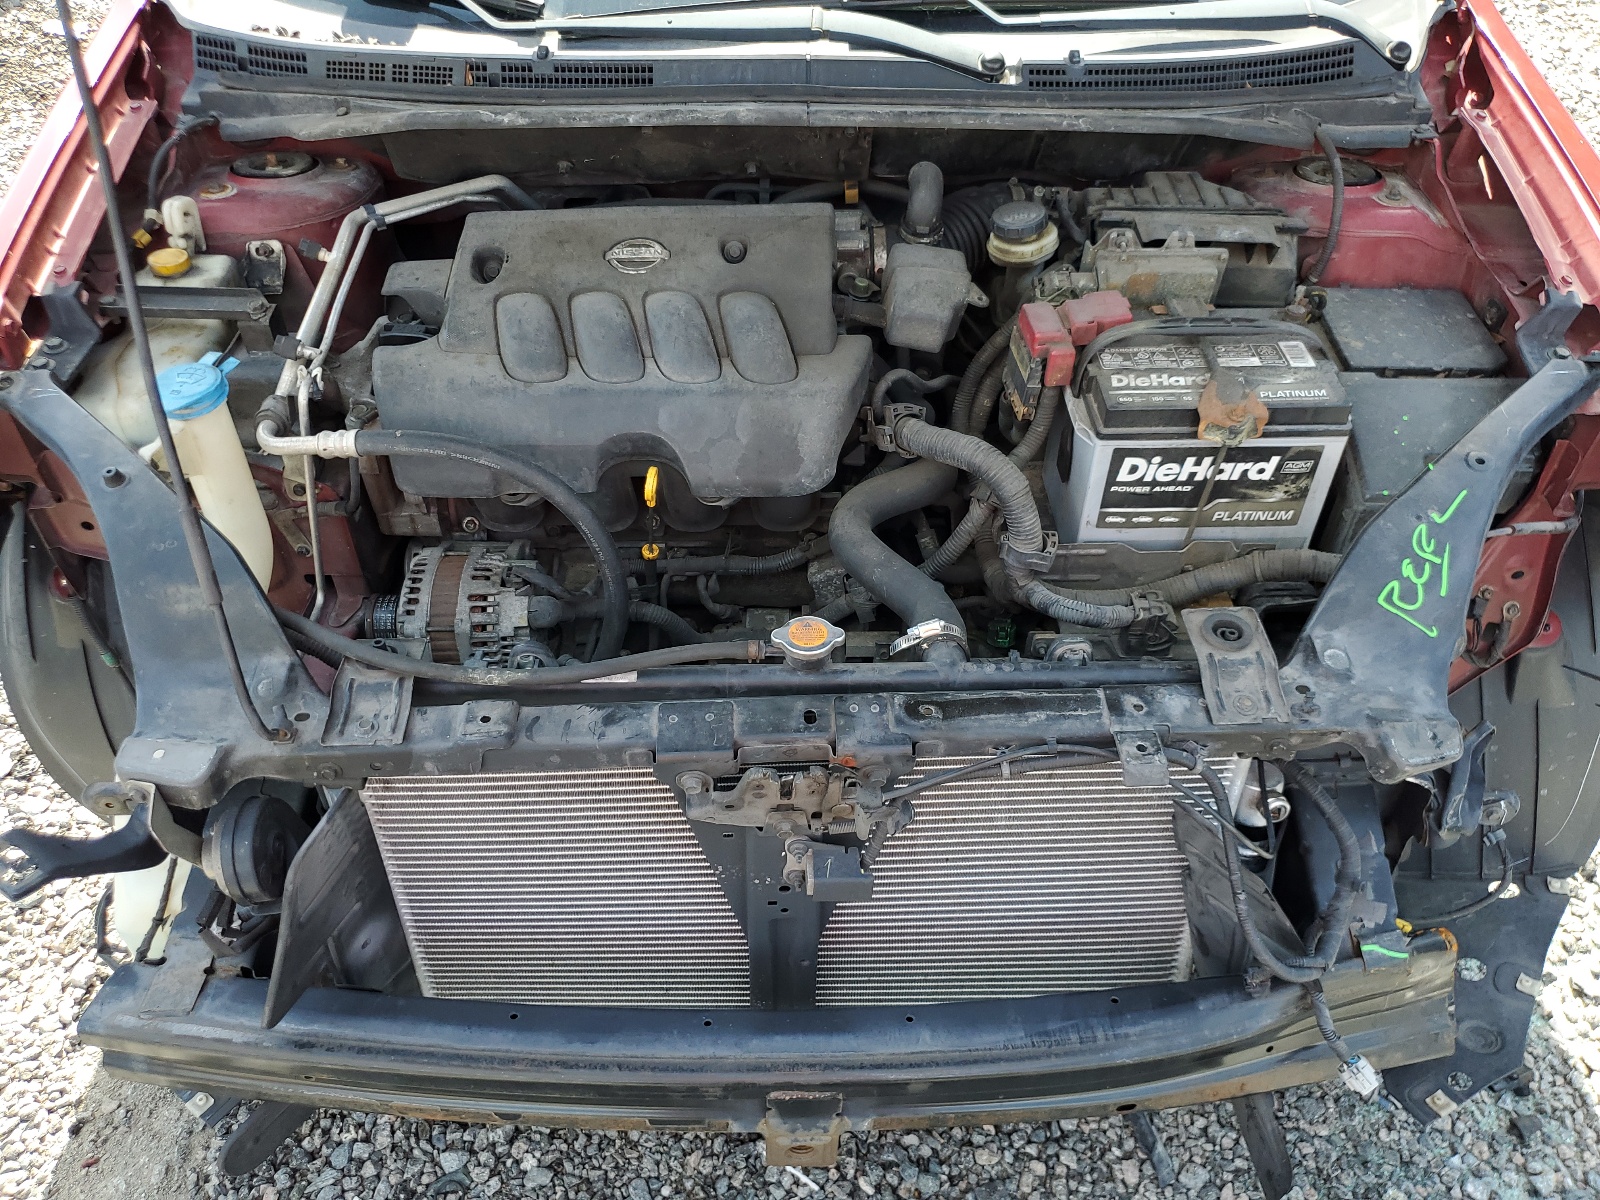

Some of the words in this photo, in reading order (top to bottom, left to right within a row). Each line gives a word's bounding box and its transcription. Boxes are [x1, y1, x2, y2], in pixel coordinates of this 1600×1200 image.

[610, 249, 664, 257] NISSAN
[1110, 373, 1210, 387] DieHard
[1259, 389, 1327, 398] PLATINUM
[1116, 455, 1280, 482] DieHard
[1285, 462, 1312, 470] AGM
[1211, 510, 1295, 522] PLATINUM
